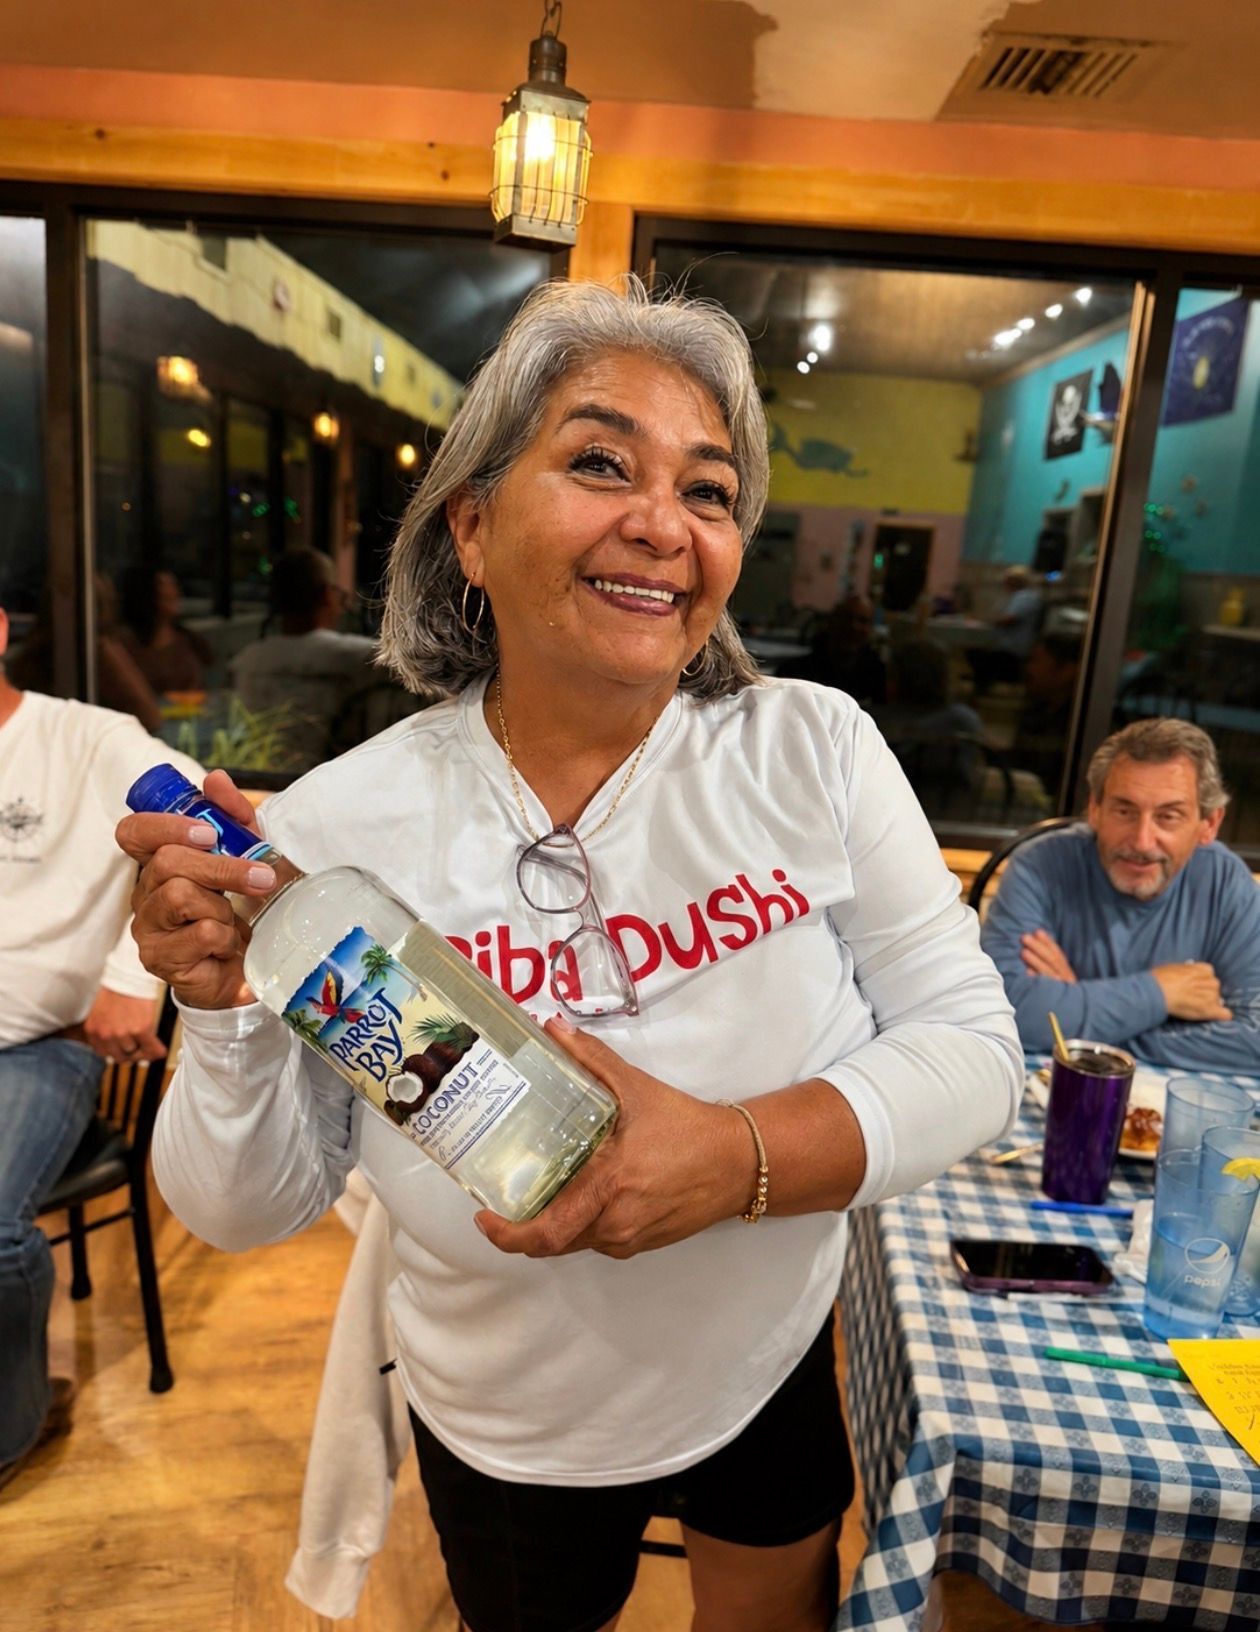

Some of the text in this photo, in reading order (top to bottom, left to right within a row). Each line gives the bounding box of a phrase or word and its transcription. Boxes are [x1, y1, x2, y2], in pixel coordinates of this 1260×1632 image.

[329, 987, 402, 1071] PARROT
[355, 1019, 402, 1082] BAY
[412, 1062, 478, 1135] COCONUT
